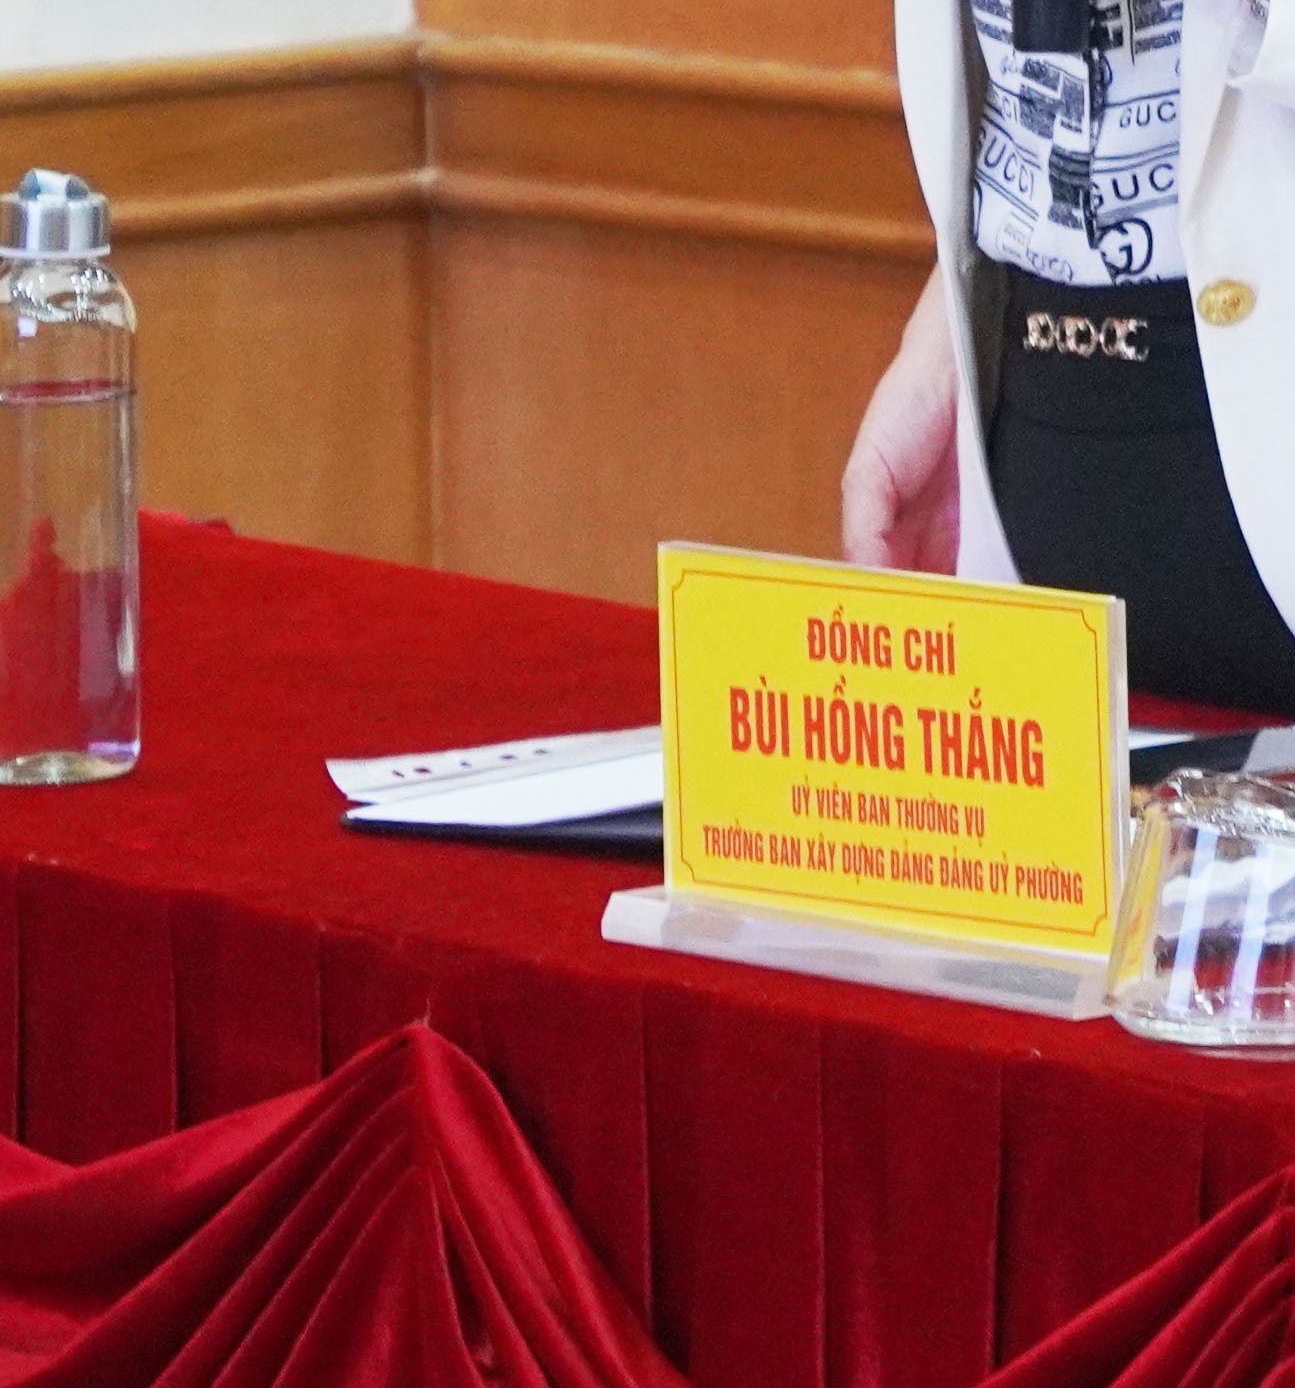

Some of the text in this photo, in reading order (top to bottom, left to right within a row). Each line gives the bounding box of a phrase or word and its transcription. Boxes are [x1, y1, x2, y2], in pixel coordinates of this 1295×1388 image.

[807, 604, 957, 676] ĐỒNG CHÍ
[729, 674, 1046, 790] BÙI HỒNG THẮNG
[815, 781, 853, 823] VIÊN
[857, 793, 891, 828] BAN
[895, 791, 961, 837] THƯỜNG
[964, 805, 986, 848] VỤ
[768, 834, 802, 869] BAN
[806, 832, 837, 873] XÂY
[841, 841, 885, 886] DỰNG
[939, 844, 984, 893] ĐẢNG
[1015, 860, 1085, 906] PHƯỜNG
